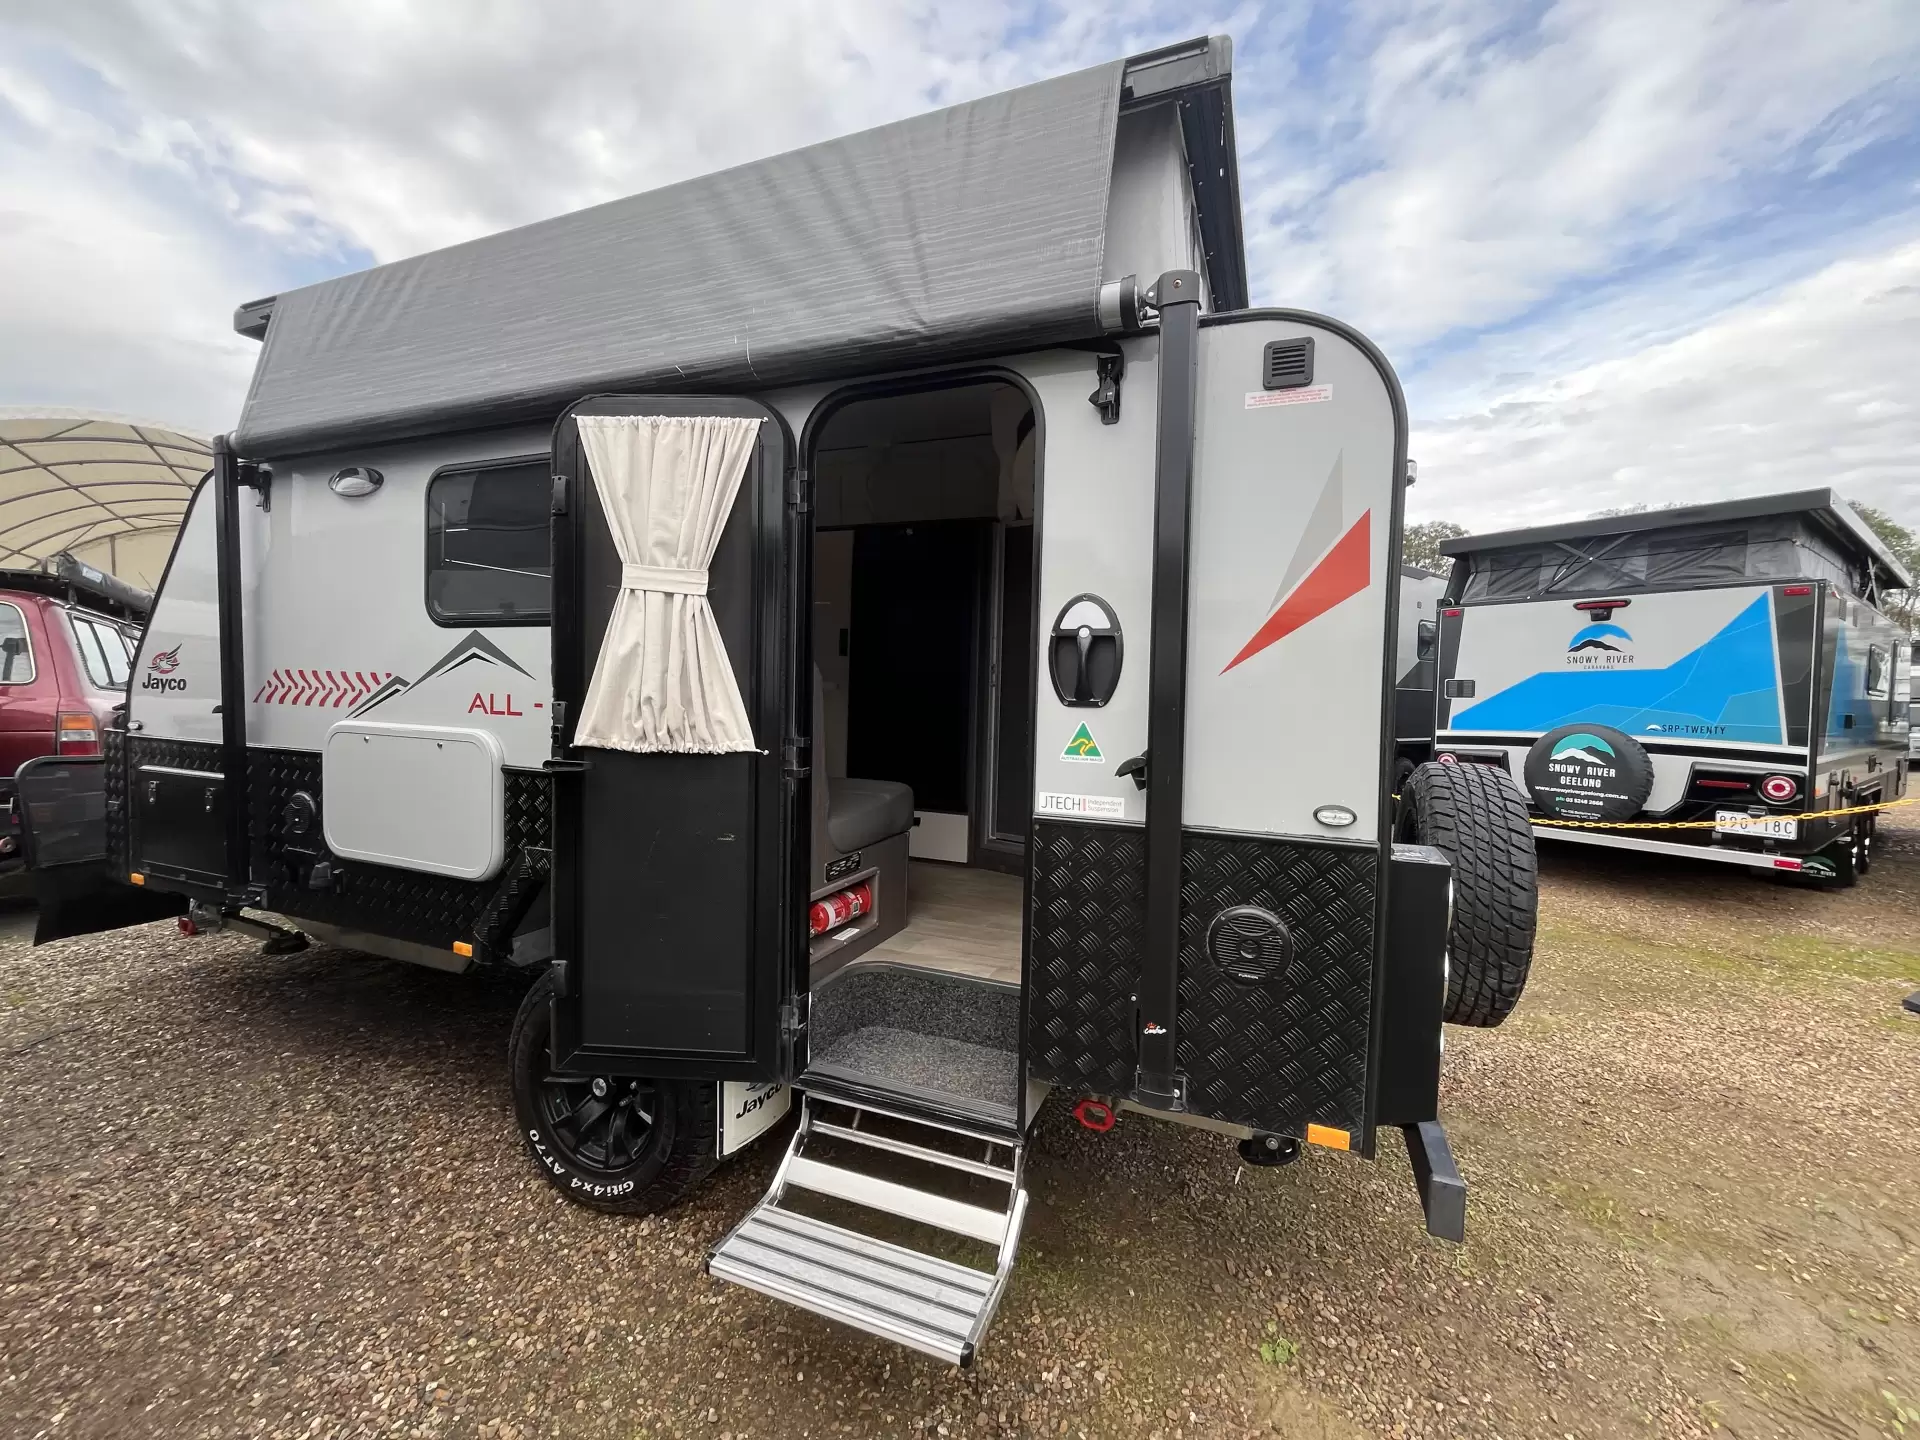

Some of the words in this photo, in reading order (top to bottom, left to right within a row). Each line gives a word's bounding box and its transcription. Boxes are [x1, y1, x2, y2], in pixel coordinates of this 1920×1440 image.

[1566, 655, 1599, 664] SNOWY
[1606, 655, 1634, 664] RIVER
[142, 672, 187, 694] Jayco
[468, 692, 523, 717] ALL
[1661, 724, 1726, 735] SRP-TWENTY
[1548, 763, 1581, 775] SNOWY
[1587, 766, 1616, 778] RIVER
[1560, 776, 1602, 788] GEELONG
[1041, 795, 1081, 811] JTECH
[735, 1083, 783, 1119] Jayco
